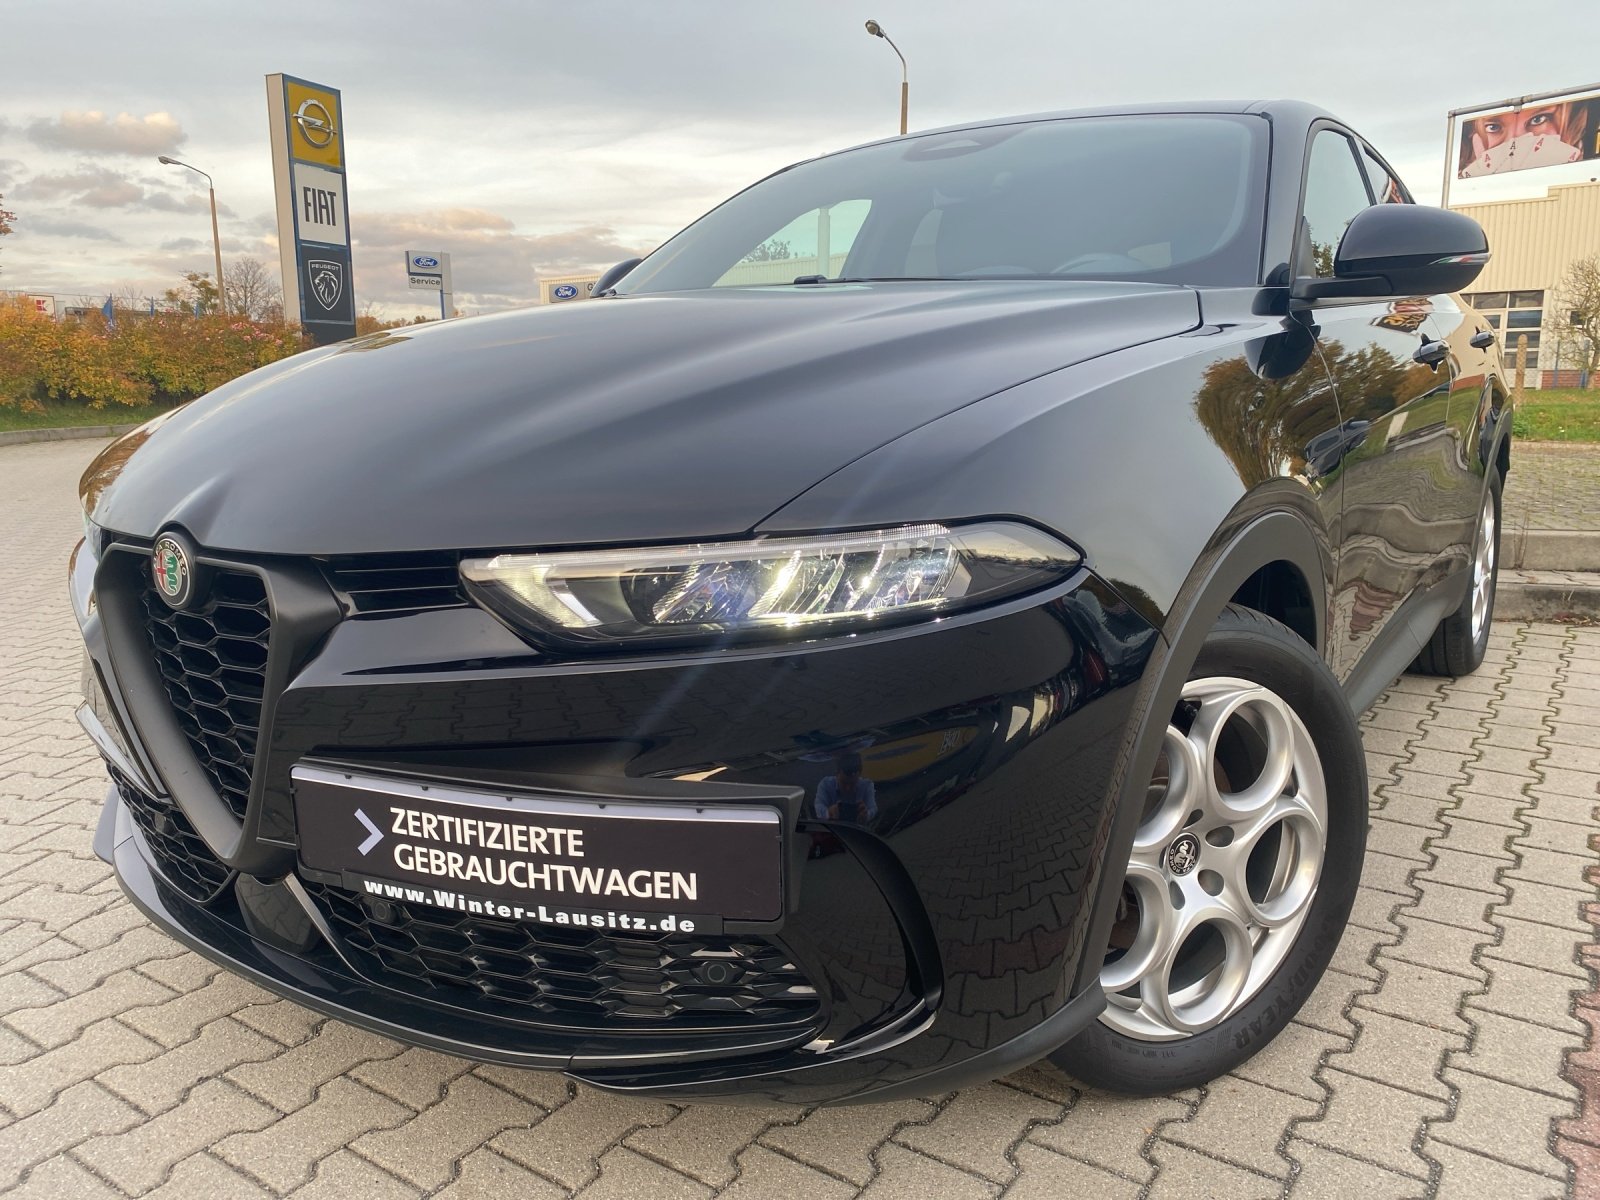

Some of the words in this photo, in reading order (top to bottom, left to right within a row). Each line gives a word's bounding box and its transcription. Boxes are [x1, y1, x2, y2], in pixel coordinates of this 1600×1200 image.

[1509, 140, 1517, 150] A
[1484, 153, 1491, 163] A
[303, 186, 337, 227] FIAT
[311, 263, 340, 271] PEUGEOT
[410, 277, 441, 286] Service
[390, 807, 585, 857] ZERTIFIZIERTE
[393, 843, 698, 900] GEBRAUCHTWAGEN
[363, 880, 696, 933] www.Winter-Lausitz.de
